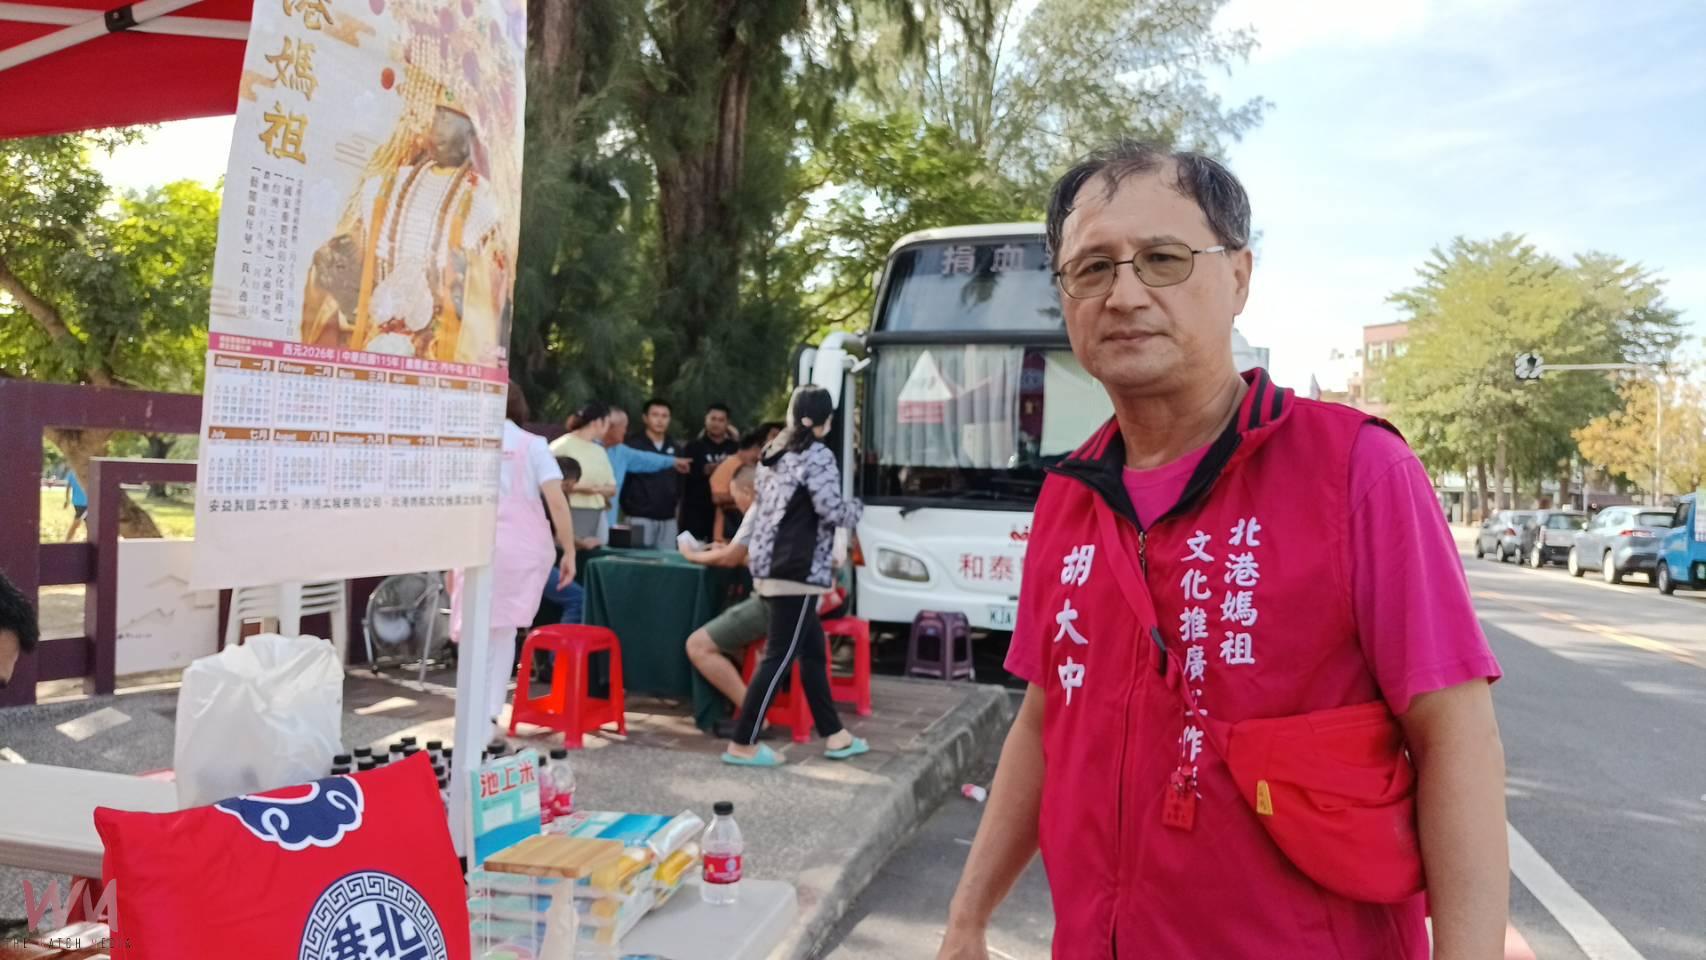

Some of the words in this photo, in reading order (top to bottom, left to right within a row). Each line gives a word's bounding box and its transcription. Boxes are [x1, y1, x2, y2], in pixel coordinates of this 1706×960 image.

[942, 244, 1053, 275] 捐血
[958, 553, 1024, 581] 和泰
[1219, 518, 1260, 665] 北港媽祖
[1053, 544, 1094, 706] 胡大中
[480, 761, 535, 798] 池上米
